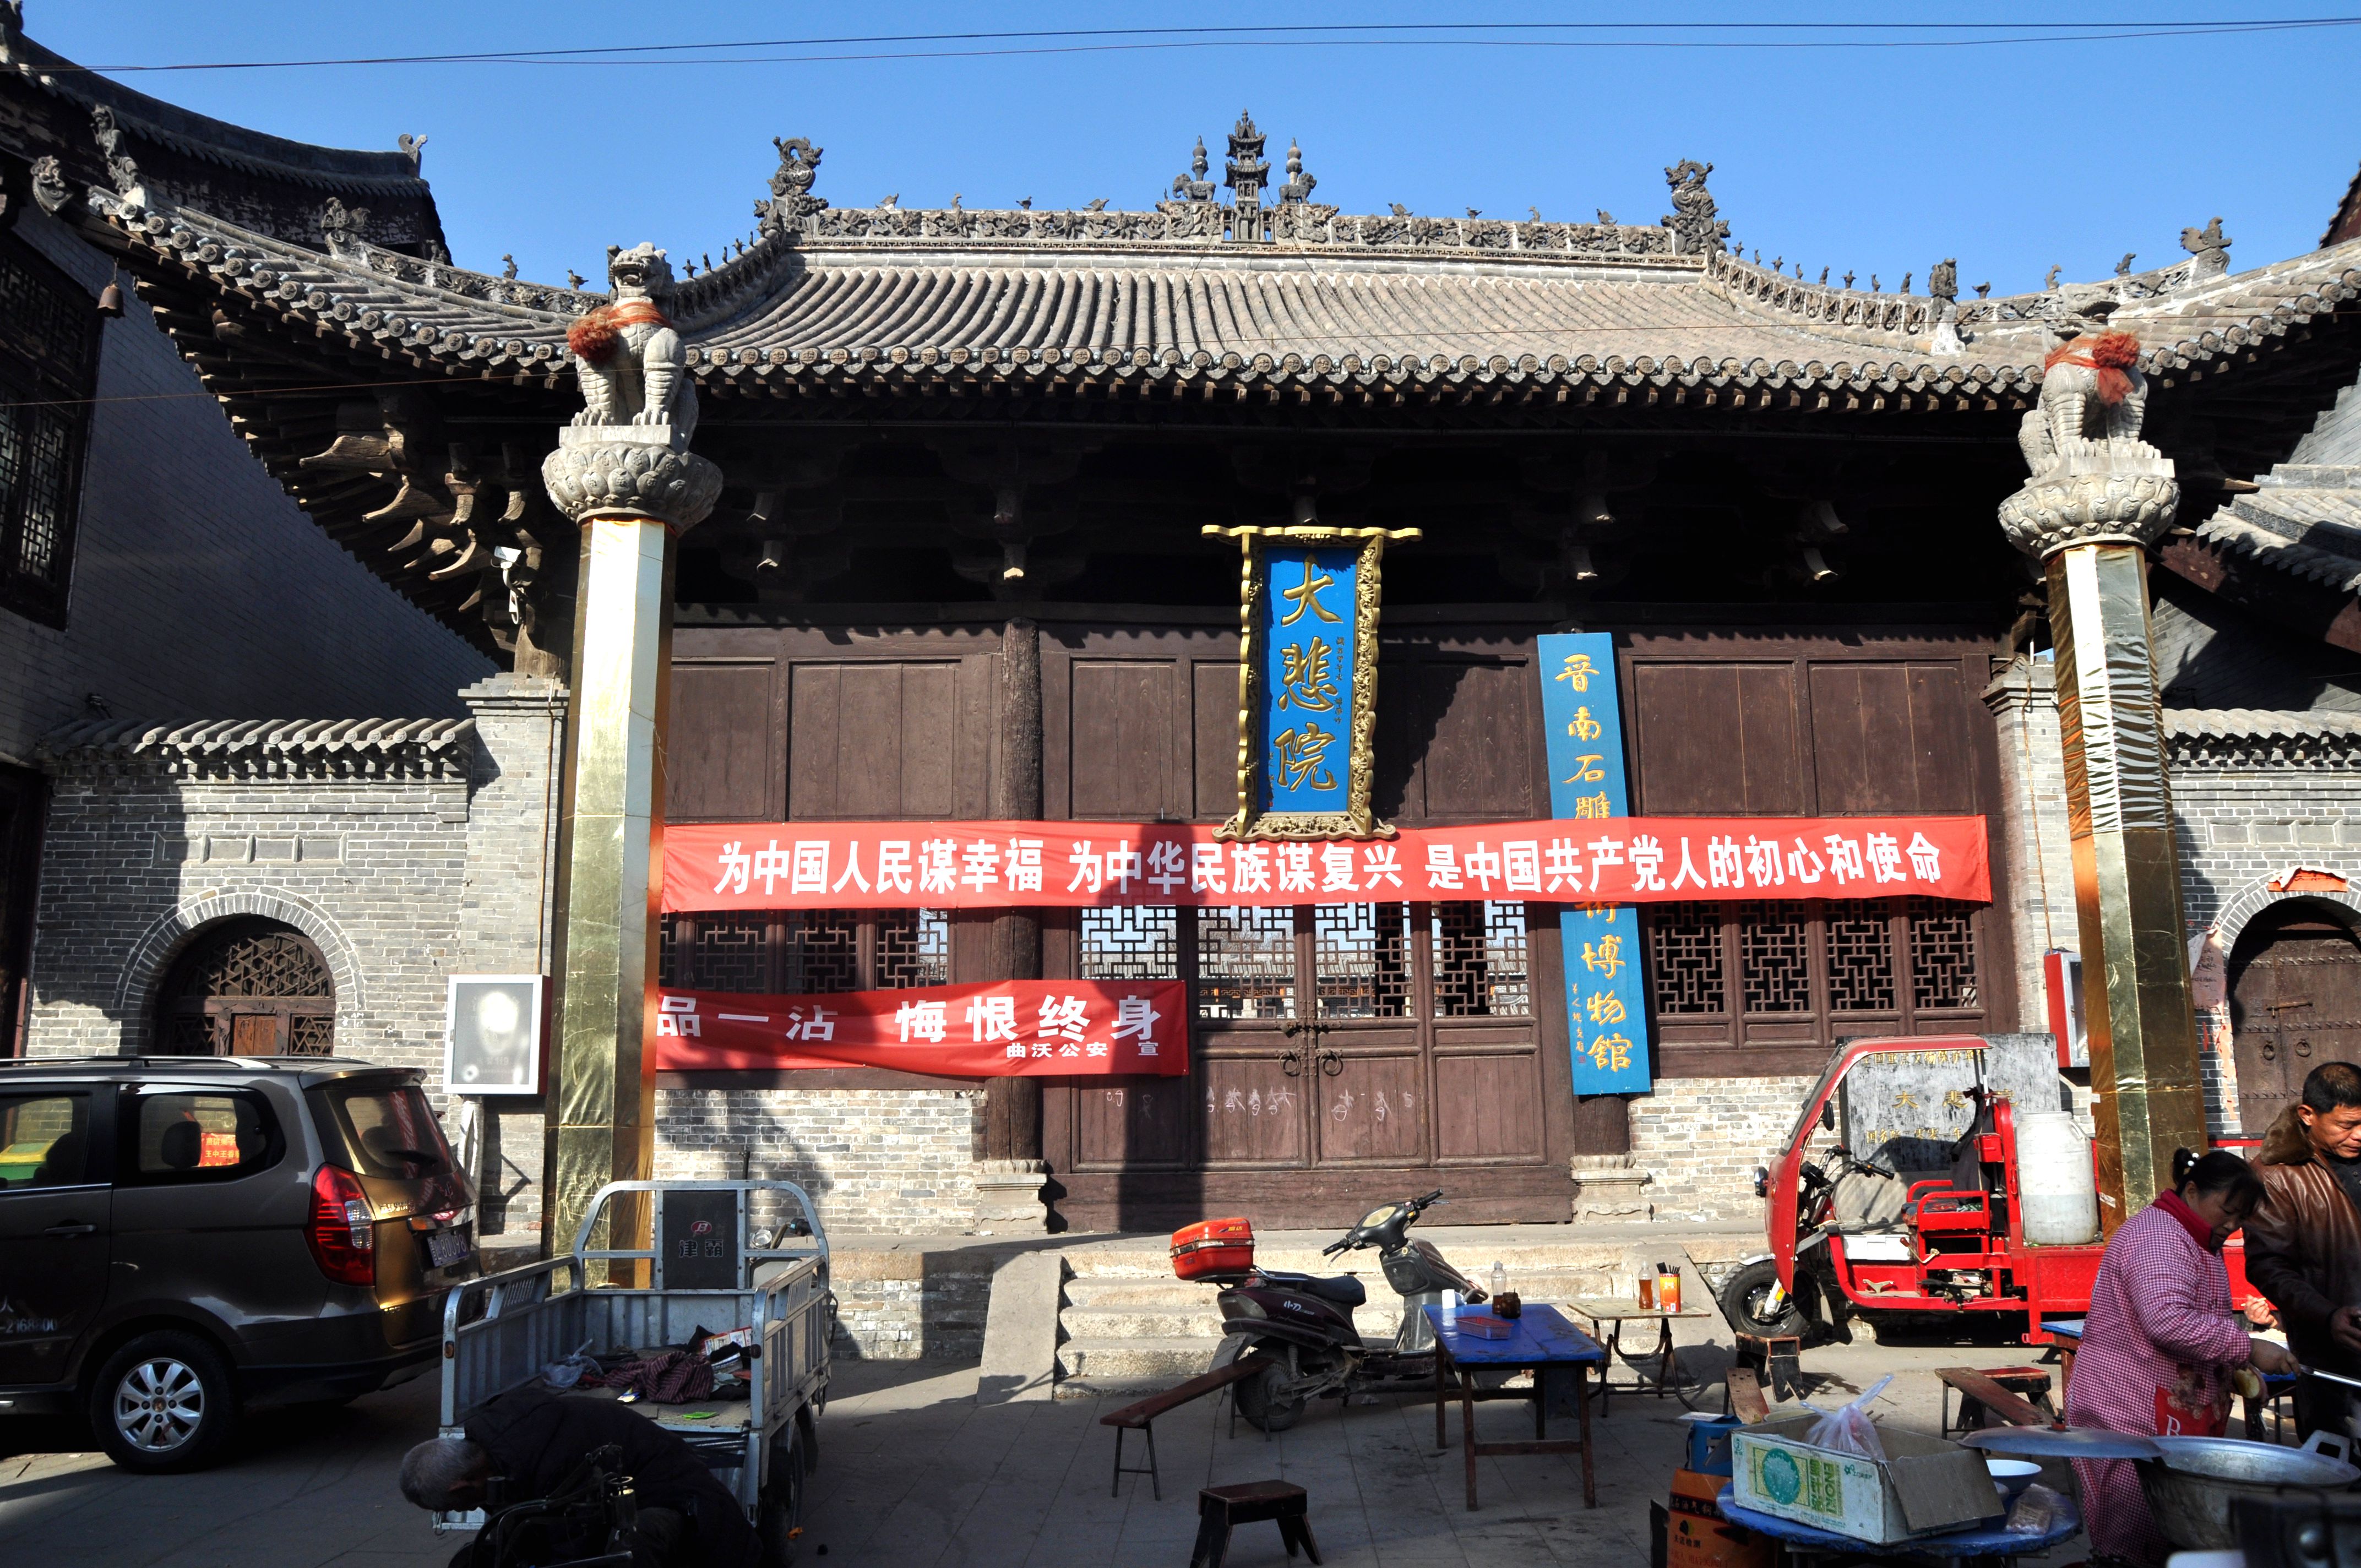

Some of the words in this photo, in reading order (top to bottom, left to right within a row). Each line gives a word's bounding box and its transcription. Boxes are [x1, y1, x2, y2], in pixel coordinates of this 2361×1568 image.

[1273, 552, 1343, 791] 大悲院
[714, 839, 1043, 895] 为中国人民谋幸福
[1067, 840, 1402, 894] 为中华民族谋复兴
[1424, 832, 1941, 893] 是中国共产党人的初心和使命
[895, 994, 1161, 1043] 悔恨终身
[1007, 1041, 1108, 1058] 曲沃公安
[1138, 1041, 1158, 1056] 宣
